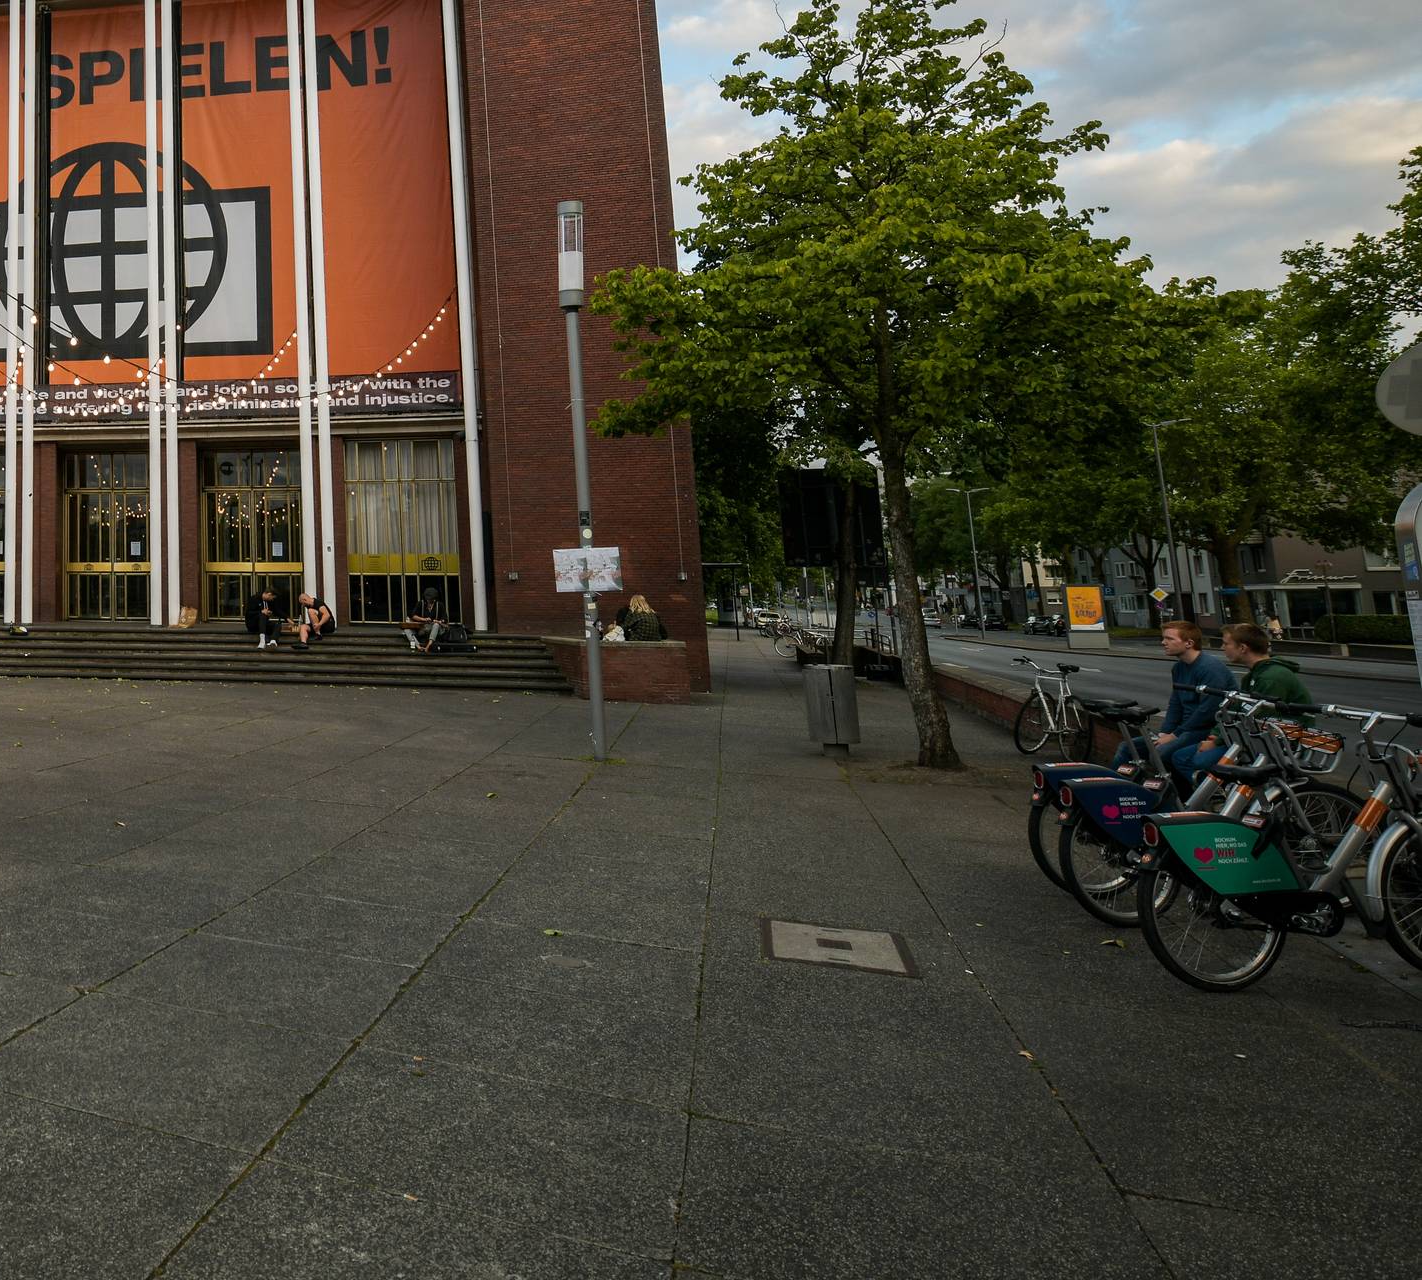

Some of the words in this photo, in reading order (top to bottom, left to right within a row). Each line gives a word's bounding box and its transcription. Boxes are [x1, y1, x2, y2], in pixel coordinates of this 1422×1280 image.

[21, 26, 391, 110] SPIELEN!
[54, 389, 88, 400] and
[176, 385, 208, 397] and
[214, 384, 247, 398] join
[253, 384, 269, 394] in
[370, 378, 412, 390] with
[418, 377, 451, 389] the
[329, 394, 359, 406] and
[366, 392, 455, 407] injustice.
